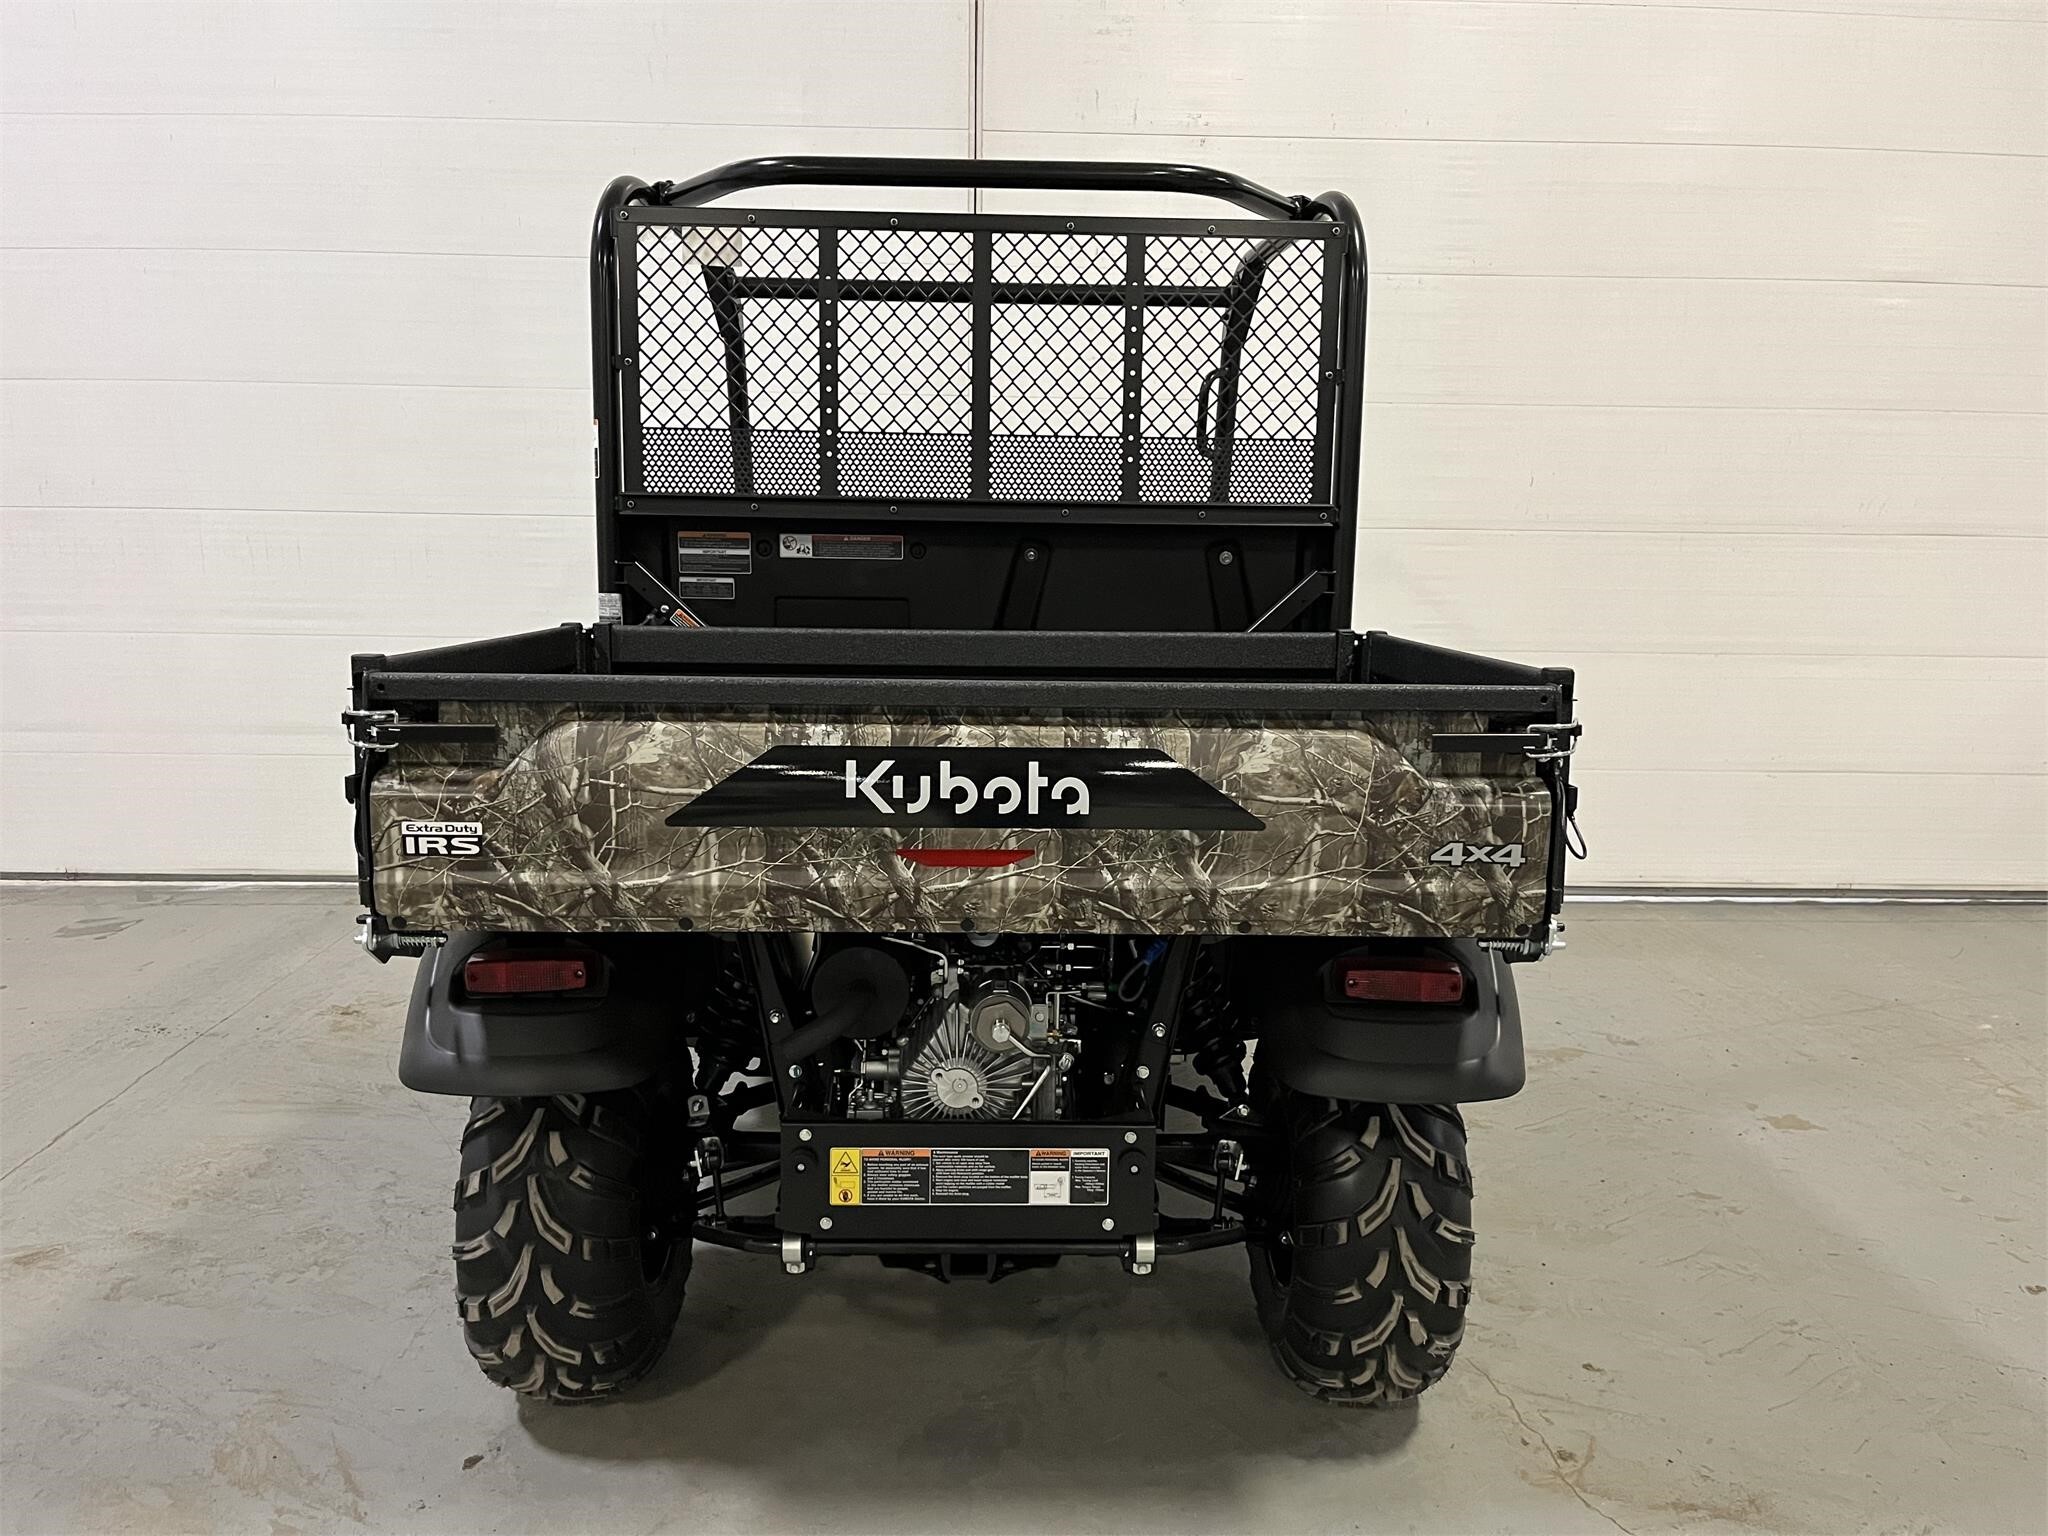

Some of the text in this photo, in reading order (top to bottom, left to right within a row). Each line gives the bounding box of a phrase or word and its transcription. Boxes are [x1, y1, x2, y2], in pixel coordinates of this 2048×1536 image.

[846, 760, 1090, 815] Kubota
[406, 824, 478, 834] Extra Duty
[405, 836, 480, 855] IRS
[1430, 842, 1526, 867] 4x4
